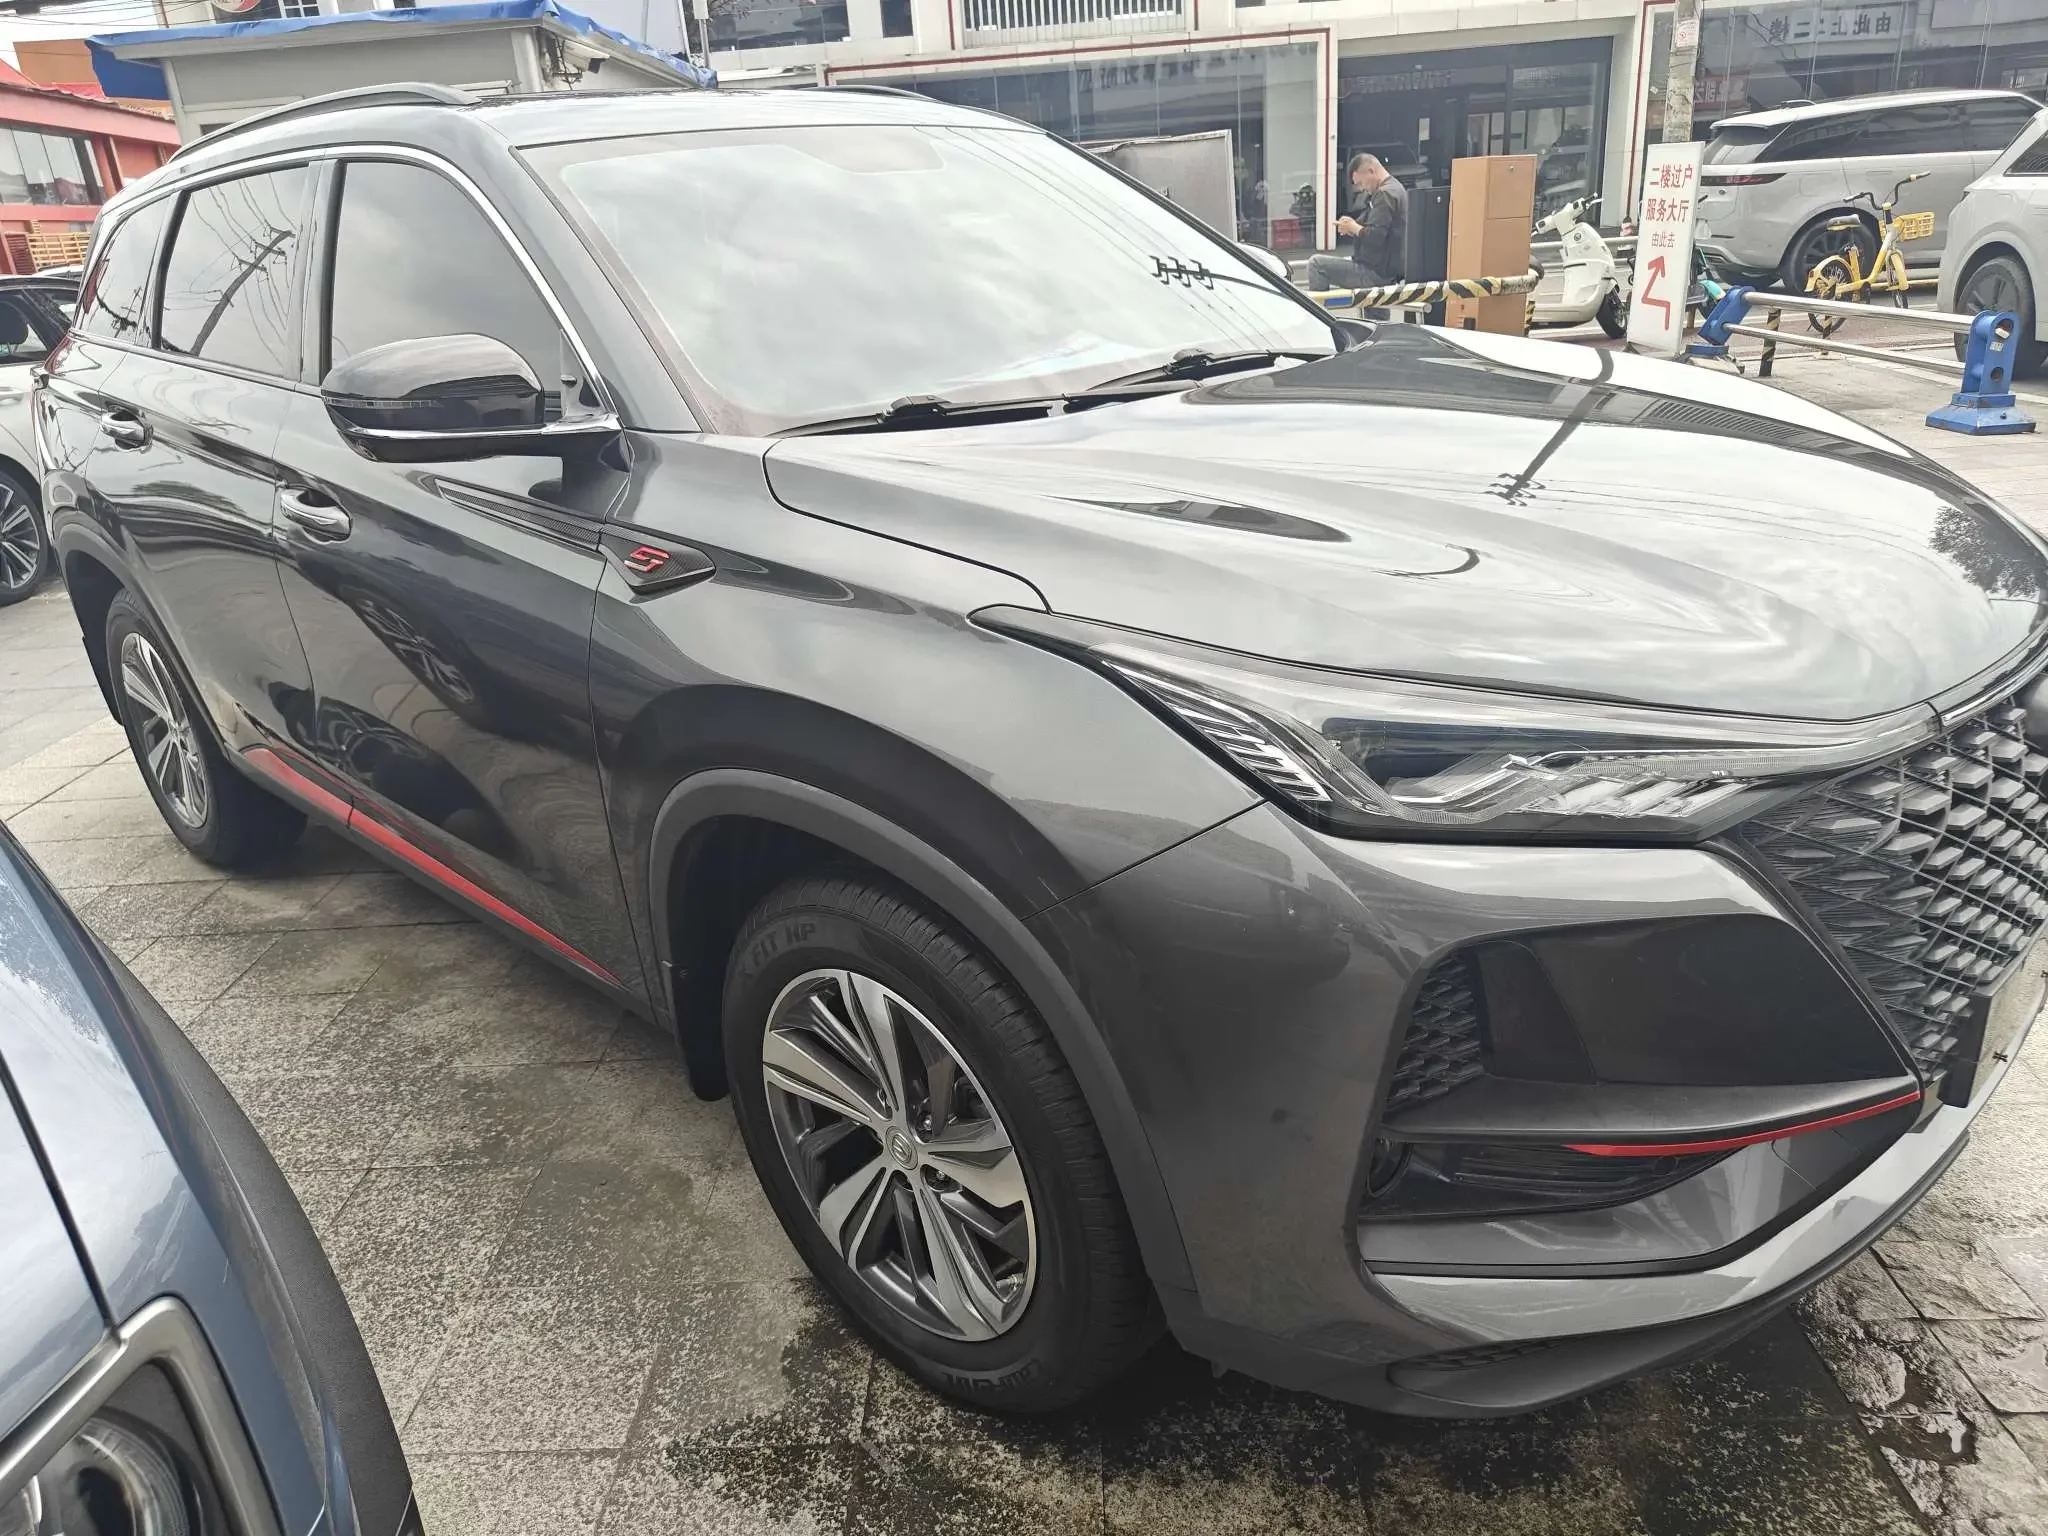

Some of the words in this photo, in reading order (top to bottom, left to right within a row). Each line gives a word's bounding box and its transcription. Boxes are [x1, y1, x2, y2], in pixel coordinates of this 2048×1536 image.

[1649, 163, 1693, 189] 二楼过户
[1646, 197, 1690, 223] 服务大厅
[1651, 231, 1676, 249] 由此去
